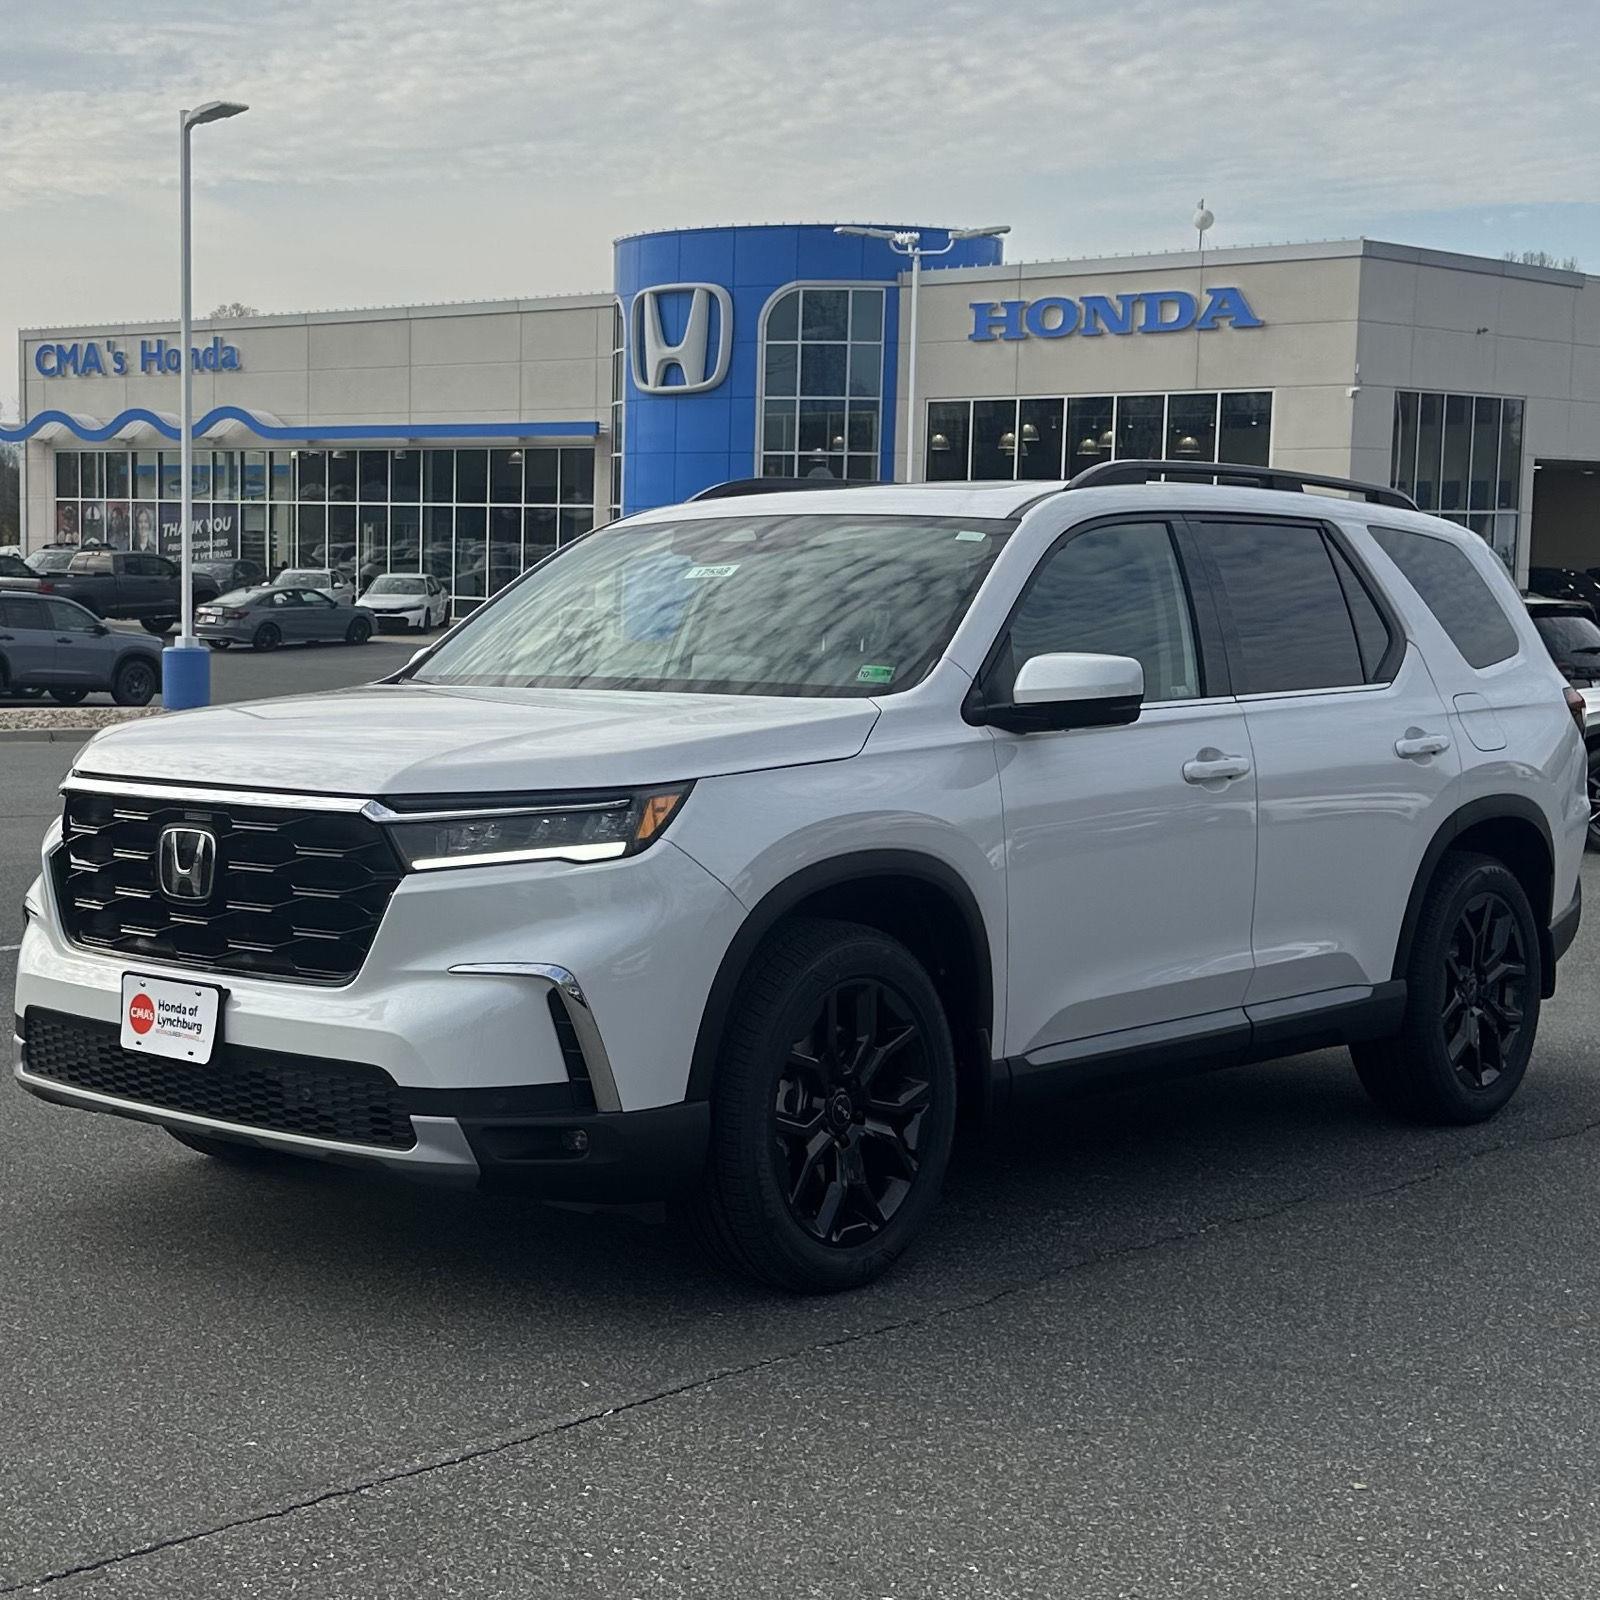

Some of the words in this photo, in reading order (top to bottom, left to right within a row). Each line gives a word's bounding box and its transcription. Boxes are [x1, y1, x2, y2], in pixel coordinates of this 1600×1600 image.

[968, 286, 1265, 342] HONDA
[35, 340, 128, 377] CMA's
[140, 336, 242, 373] Honda
[206, 516, 232, 533] YOU
[130, 1007, 154, 1021] CMA's
[158, 999, 187, 1015] Honda
[188, 1005, 198, 1017] of
[157, 1012, 203, 1034] Lynchburg
